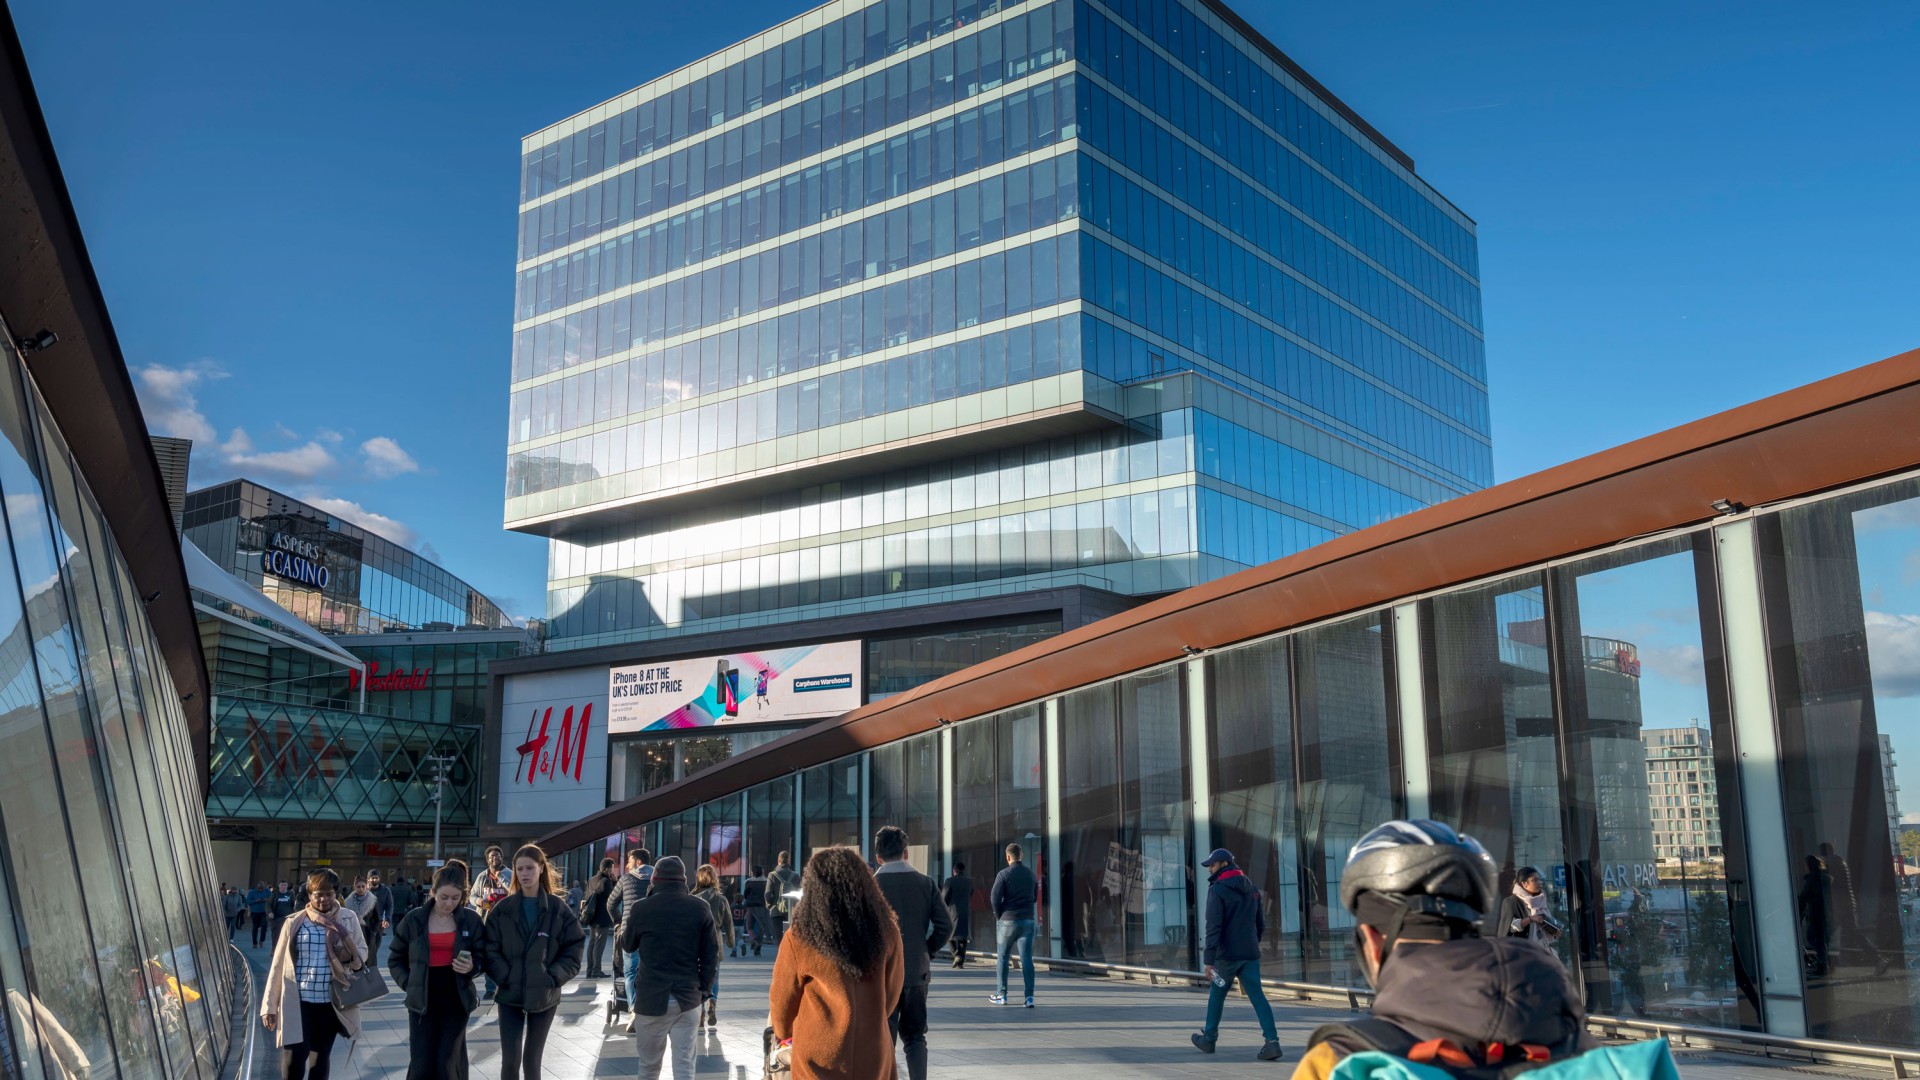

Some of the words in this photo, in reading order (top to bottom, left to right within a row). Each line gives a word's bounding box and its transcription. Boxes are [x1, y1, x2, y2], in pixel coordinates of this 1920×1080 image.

[274, 532, 319, 560] ASPERS
[272, 550, 329, 588] CASINO
[348, 661, 432, 692] Westfield
[613, 670, 637, 684] iPhone
[639, 669, 645, 682] 8
[646, 668, 655, 681] AT
[656, 667, 670, 679] THE
[795, 680, 820, 688] Carphone
[820, 677, 850, 685] Warehouse
[612, 684, 628, 698] UK'S
[629, 682, 658, 696] LOWEST
[660, 680, 682, 693] PRICE
[515, 702, 593, 785] H&M
[1602, 864, 1629, 887] AR
